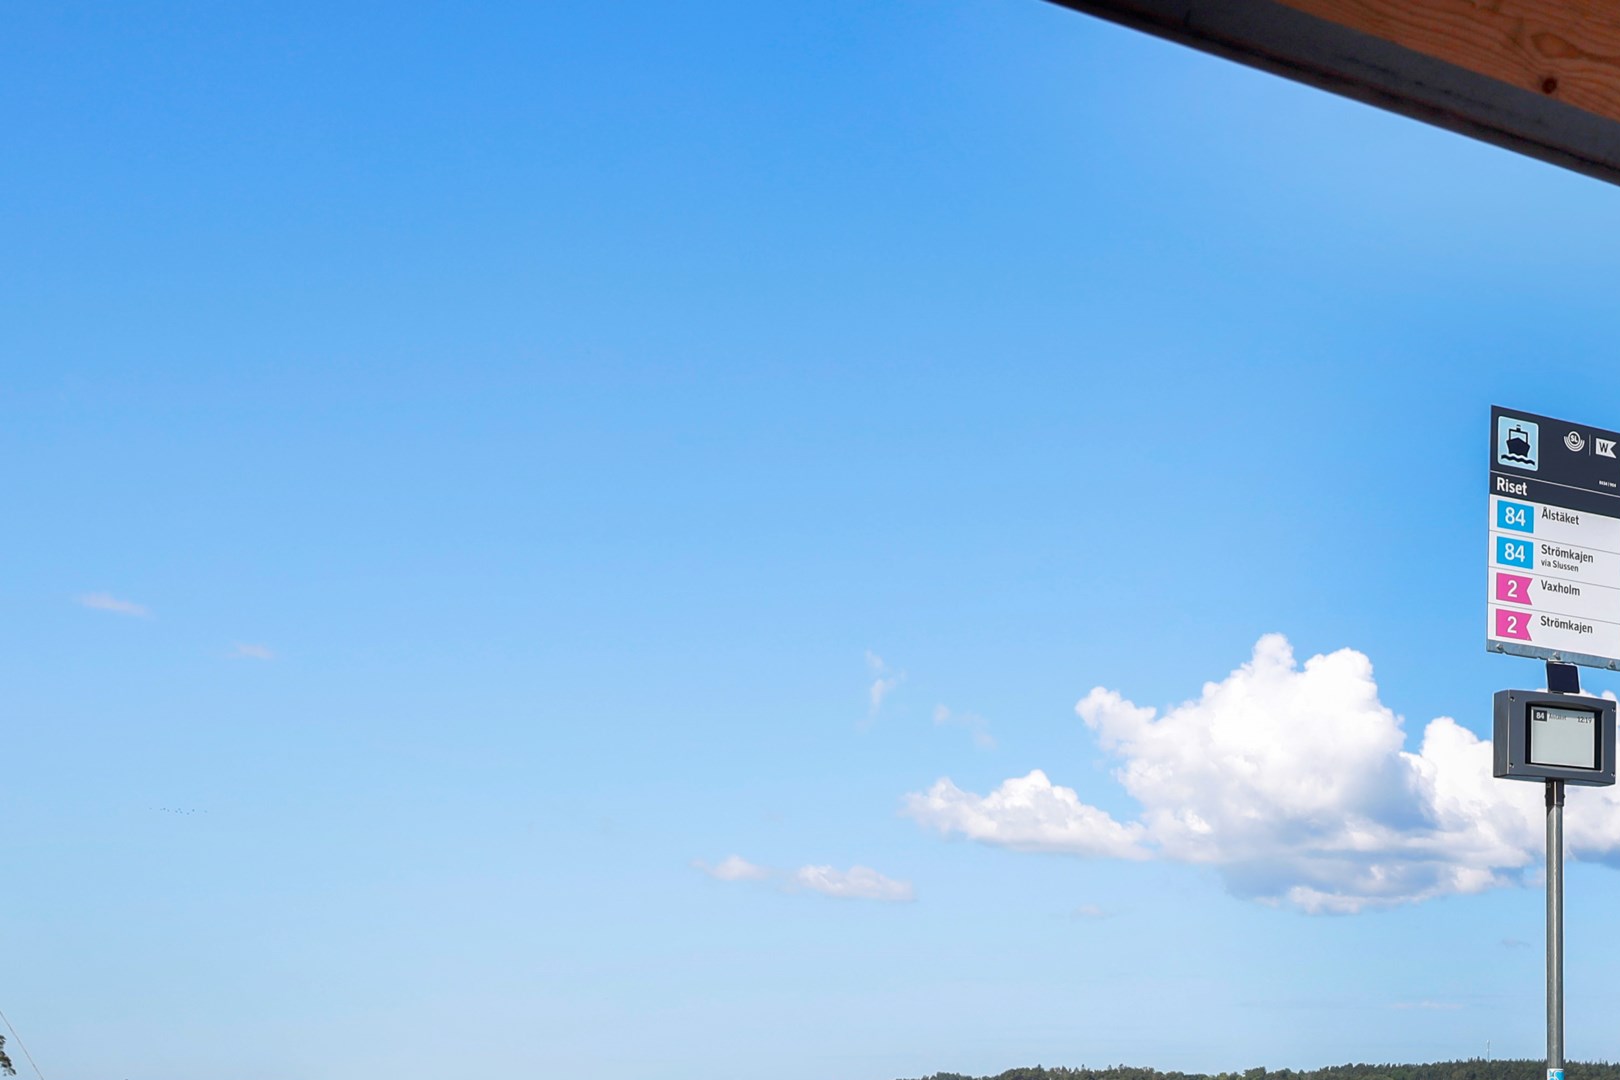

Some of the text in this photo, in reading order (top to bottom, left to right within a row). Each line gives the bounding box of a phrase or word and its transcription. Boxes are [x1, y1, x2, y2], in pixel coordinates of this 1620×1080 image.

[1496, 476, 1528, 496] Riset
[1504, 506, 1580, 527] 84 Ålstäket
[1504, 542, 1594, 564] 84 Strömkajen
[1540, 558, 1579, 573] via Slussen
[1507, 579, 1581, 598] 2 Vaxholm
[1506, 615, 1593, 635] 2 Strömkajen
[1536, 711, 1545, 720] 84
